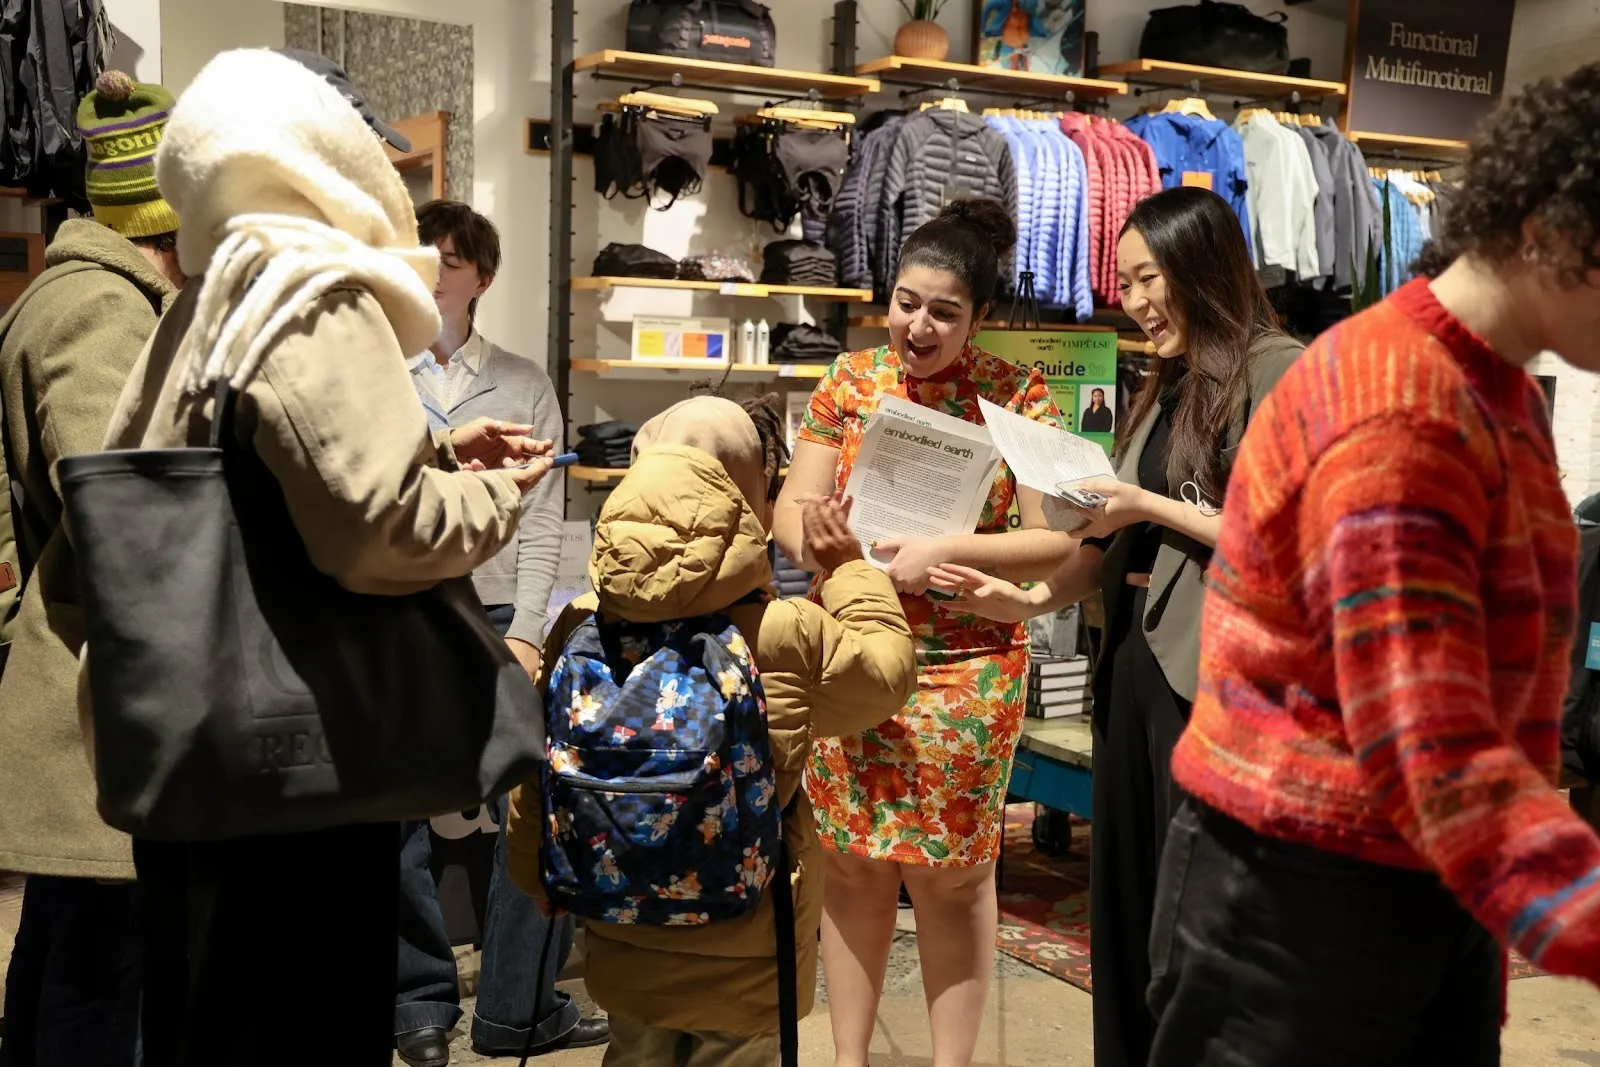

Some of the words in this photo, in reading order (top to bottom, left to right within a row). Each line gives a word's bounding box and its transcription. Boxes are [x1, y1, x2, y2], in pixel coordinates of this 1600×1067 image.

[1389, 22, 1479, 57] Functional
[1364, 55, 1493, 94] Multifunctional
[1068, 337, 1110, 349] IMPULSE
[1034, 360, 1085, 376] Guide
[1089, 362, 1106, 376] to
[884, 407, 916, 422] embodied
[884, 427, 943, 450] embodied
[944, 444, 974, 460] earth
